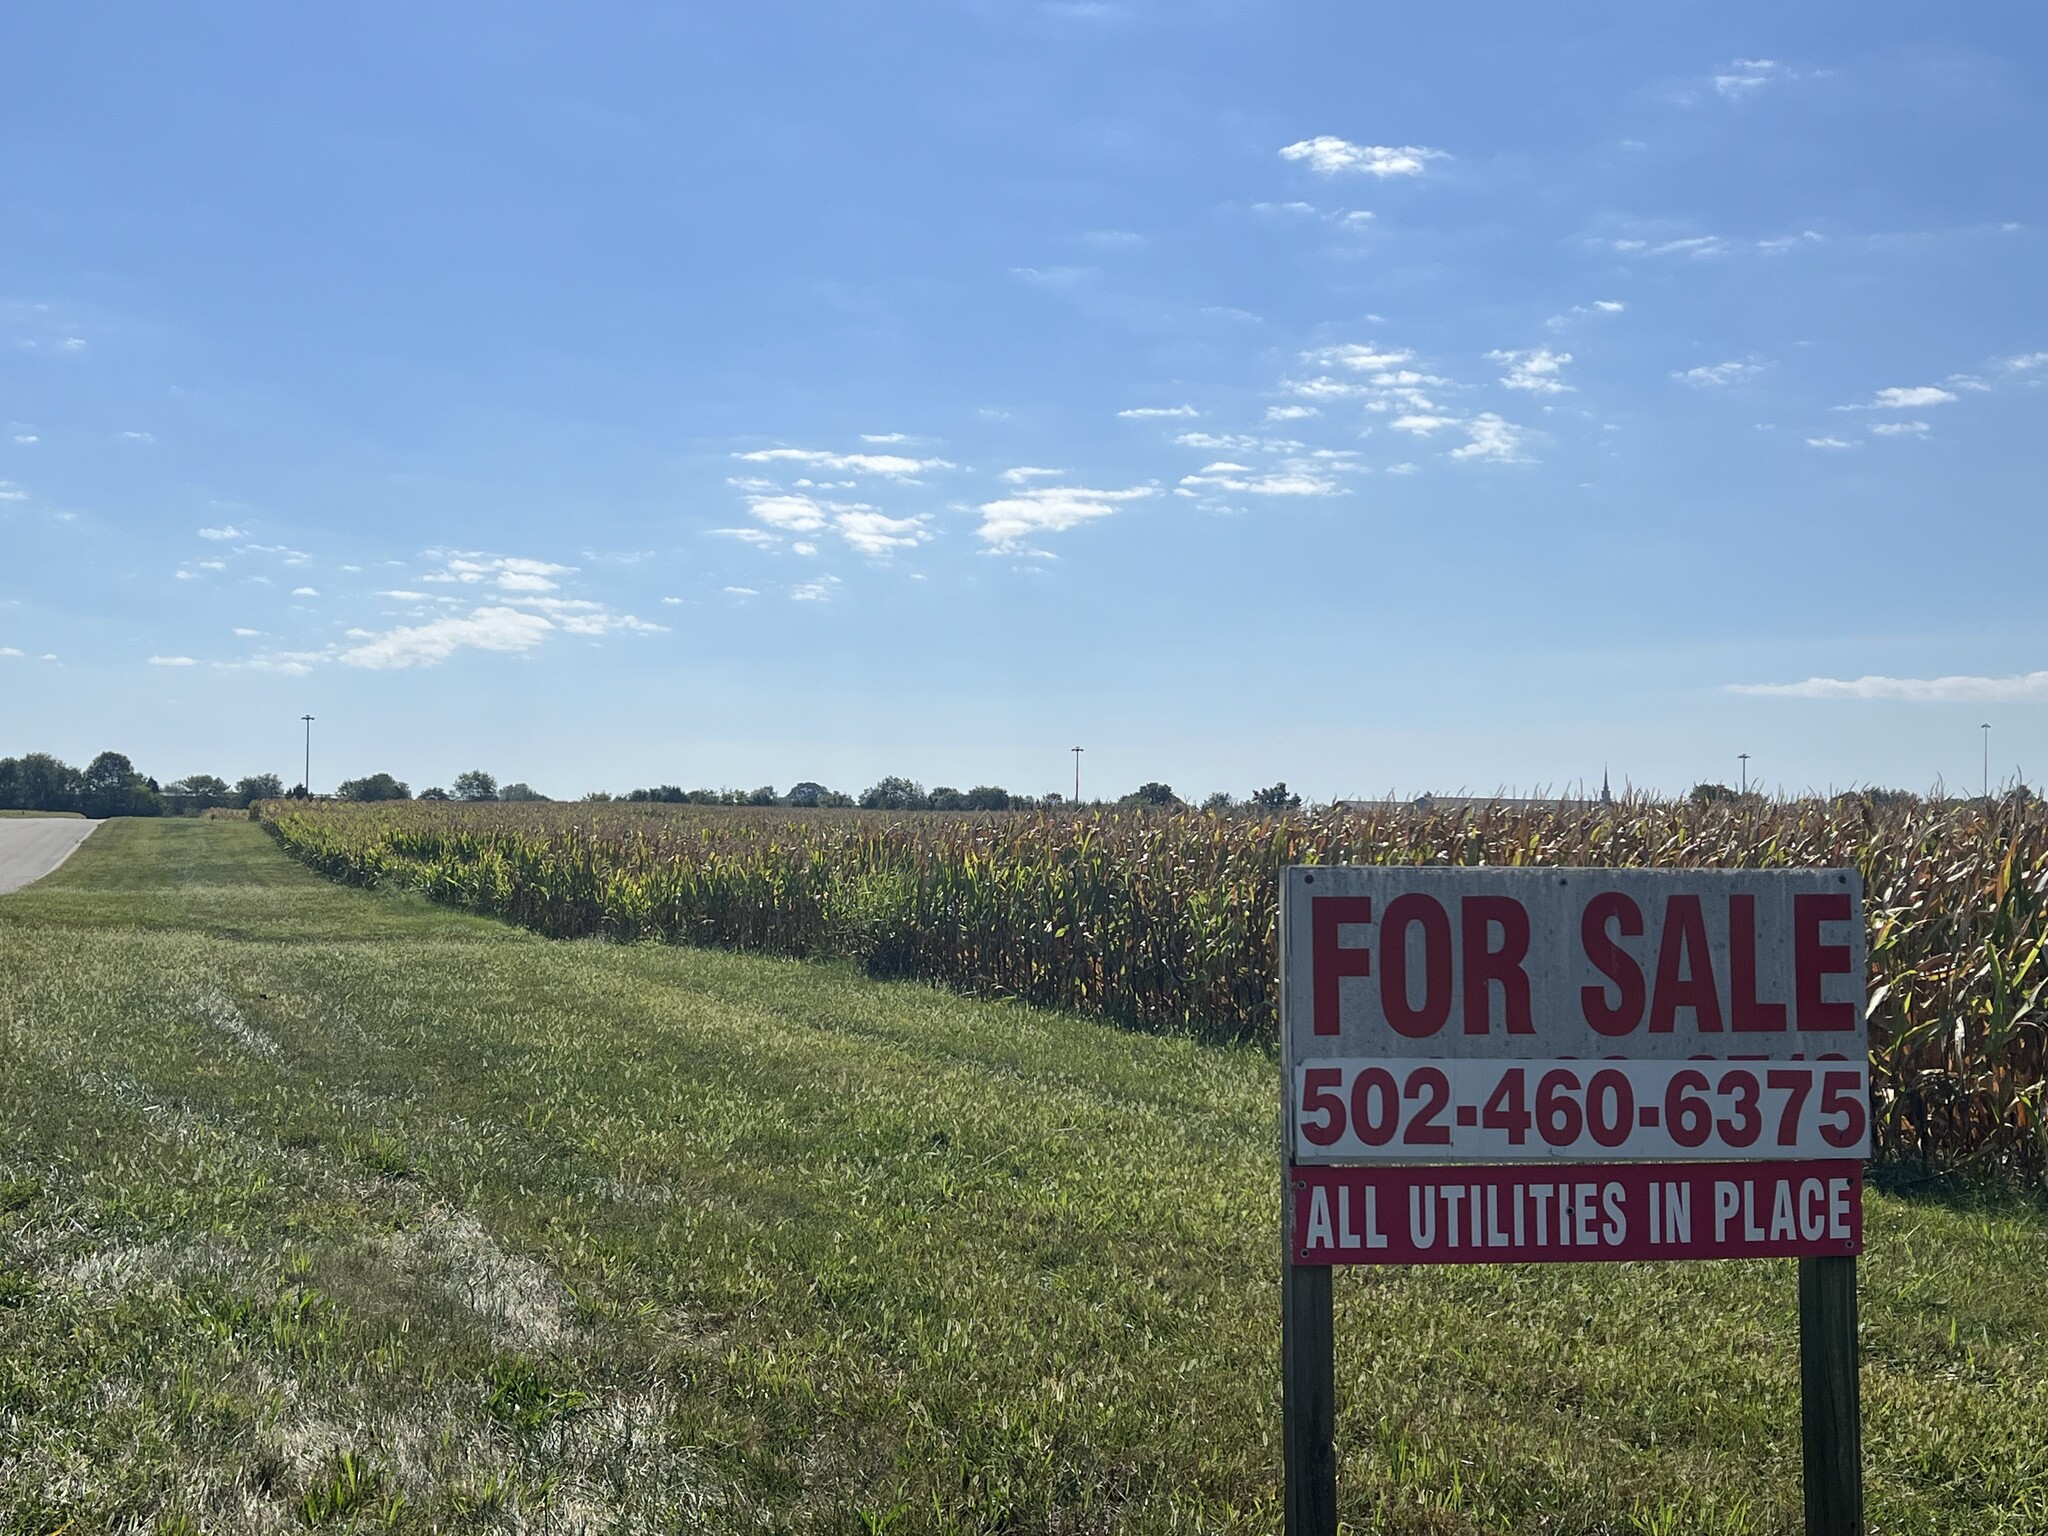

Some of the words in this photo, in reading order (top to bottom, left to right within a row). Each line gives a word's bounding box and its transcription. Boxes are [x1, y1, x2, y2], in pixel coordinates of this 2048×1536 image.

[1312, 893, 1536, 1038] FOR
[1580, 892, 1856, 1036] SALE
[1301, 1067, 1866, 1148] 502-460-6375
[1306, 1185, 1388, 1249] ALL
[1409, 1182, 1627, 1249] UTILITIES
[1649, 1182, 1691, 1244] IN
[1714, 1178, 1852, 1243] PLACE
